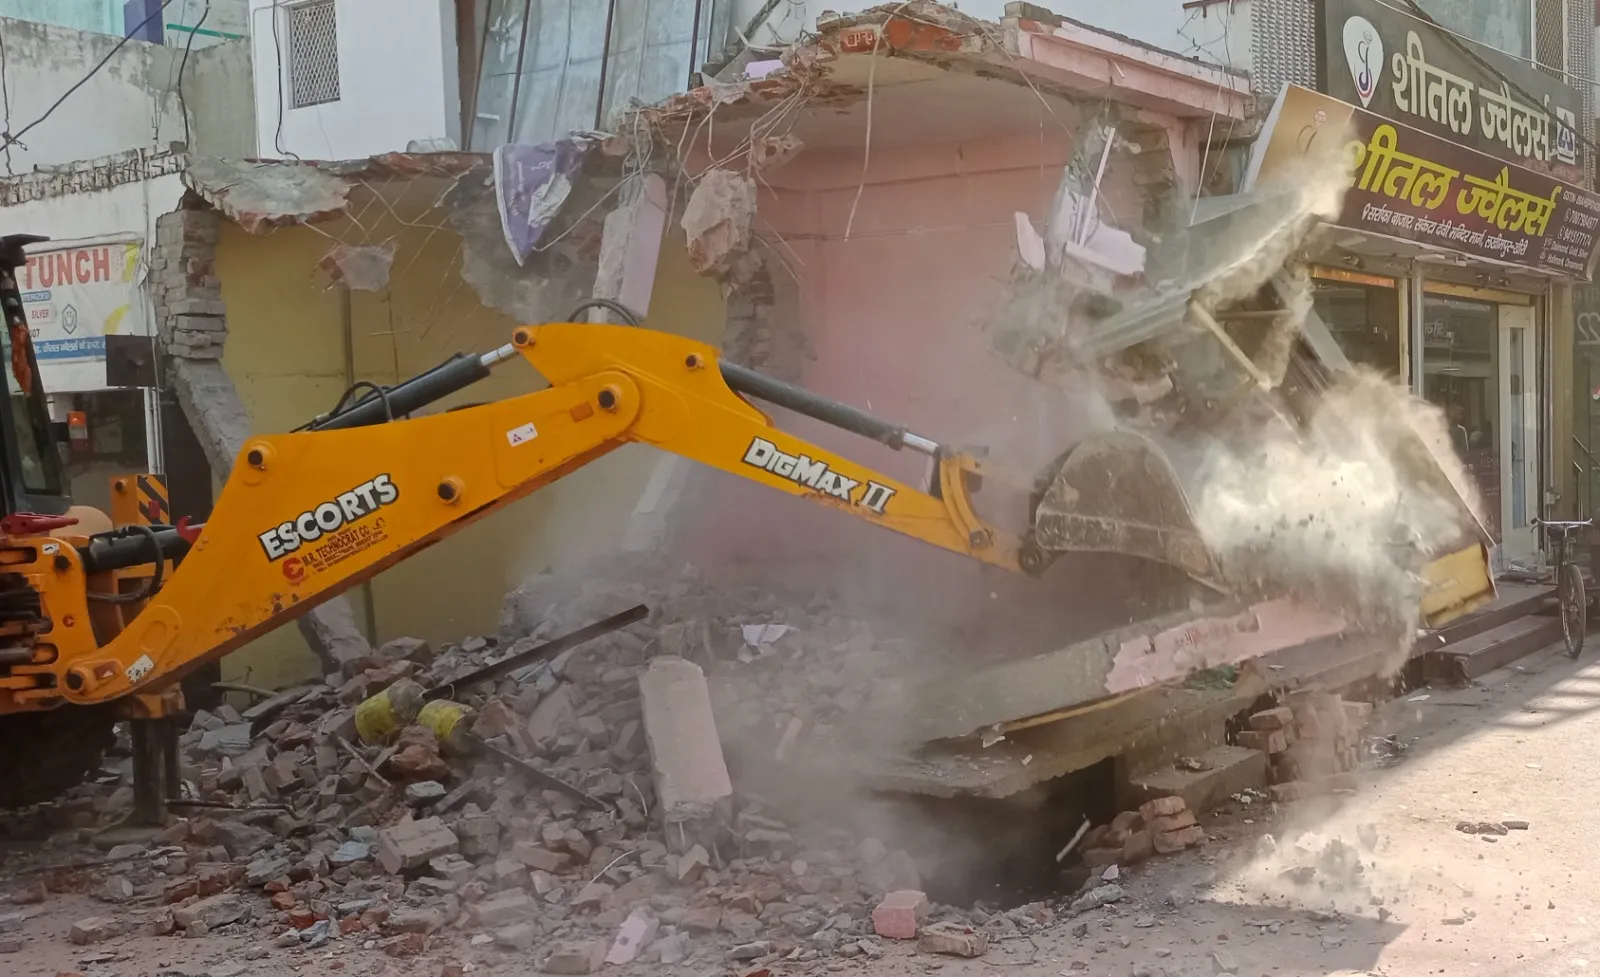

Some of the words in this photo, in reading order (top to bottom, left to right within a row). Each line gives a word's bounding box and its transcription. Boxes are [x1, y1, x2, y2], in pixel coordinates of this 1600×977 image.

[1392, 30, 1473, 135] शीतल
[1343, 124, 1459, 209] शीतल
[1456, 166, 1562, 237] ज्वैलर्स
[25, 248, 110, 290] TUNCH
[32, 309, 50, 320] SILVER
[258, 473, 398, 562] ESCORTS
[315, 529, 360, 560] TECHNOCRAT
